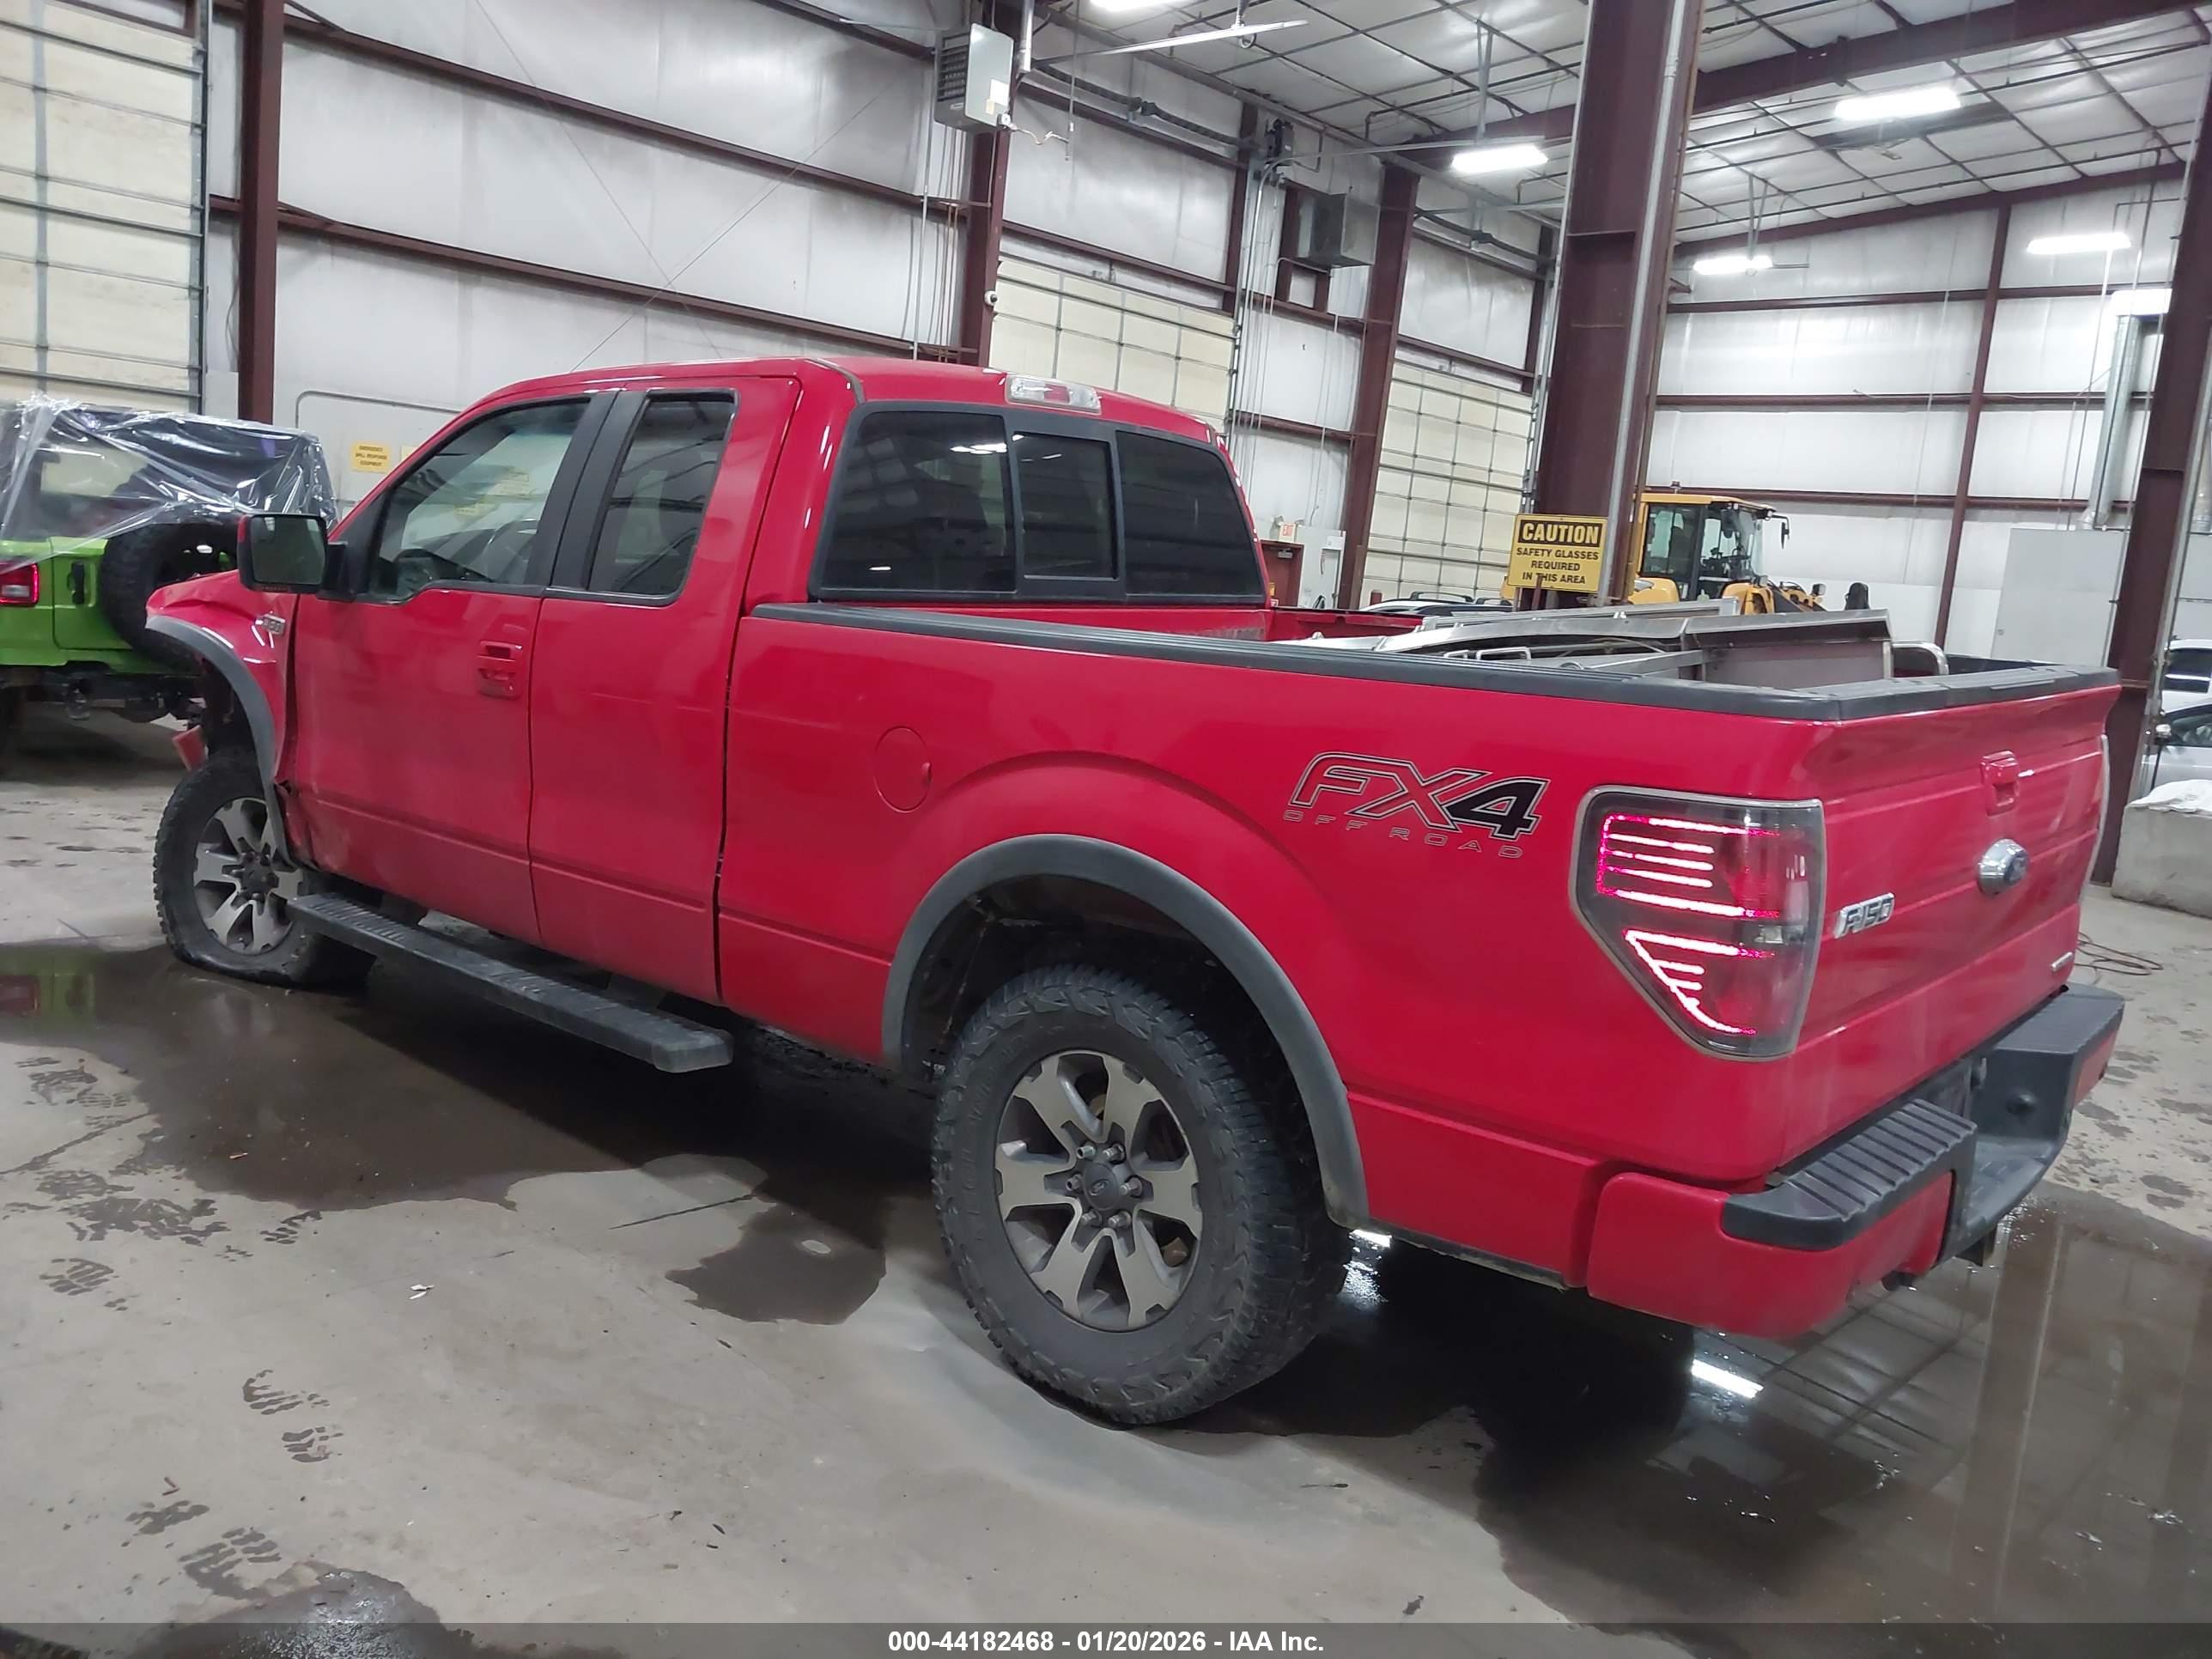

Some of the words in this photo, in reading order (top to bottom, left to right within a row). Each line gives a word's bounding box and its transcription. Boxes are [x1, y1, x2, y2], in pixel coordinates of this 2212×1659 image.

[1522, 522, 1600, 544] CAUTION
[1516, 547, 1553, 557] SAFETY
[1554, 550, 1599, 560] GLASSES
[1530, 561, 1580, 571] REQUIRED
[1522, 572, 1533, 580] IN
[1560, 574, 1586, 585] AREA
[1288, 751, 1552, 842] FX4
[1283, 809, 1369, 831] OFF
[1388, 826, 1524, 860] ROAD
